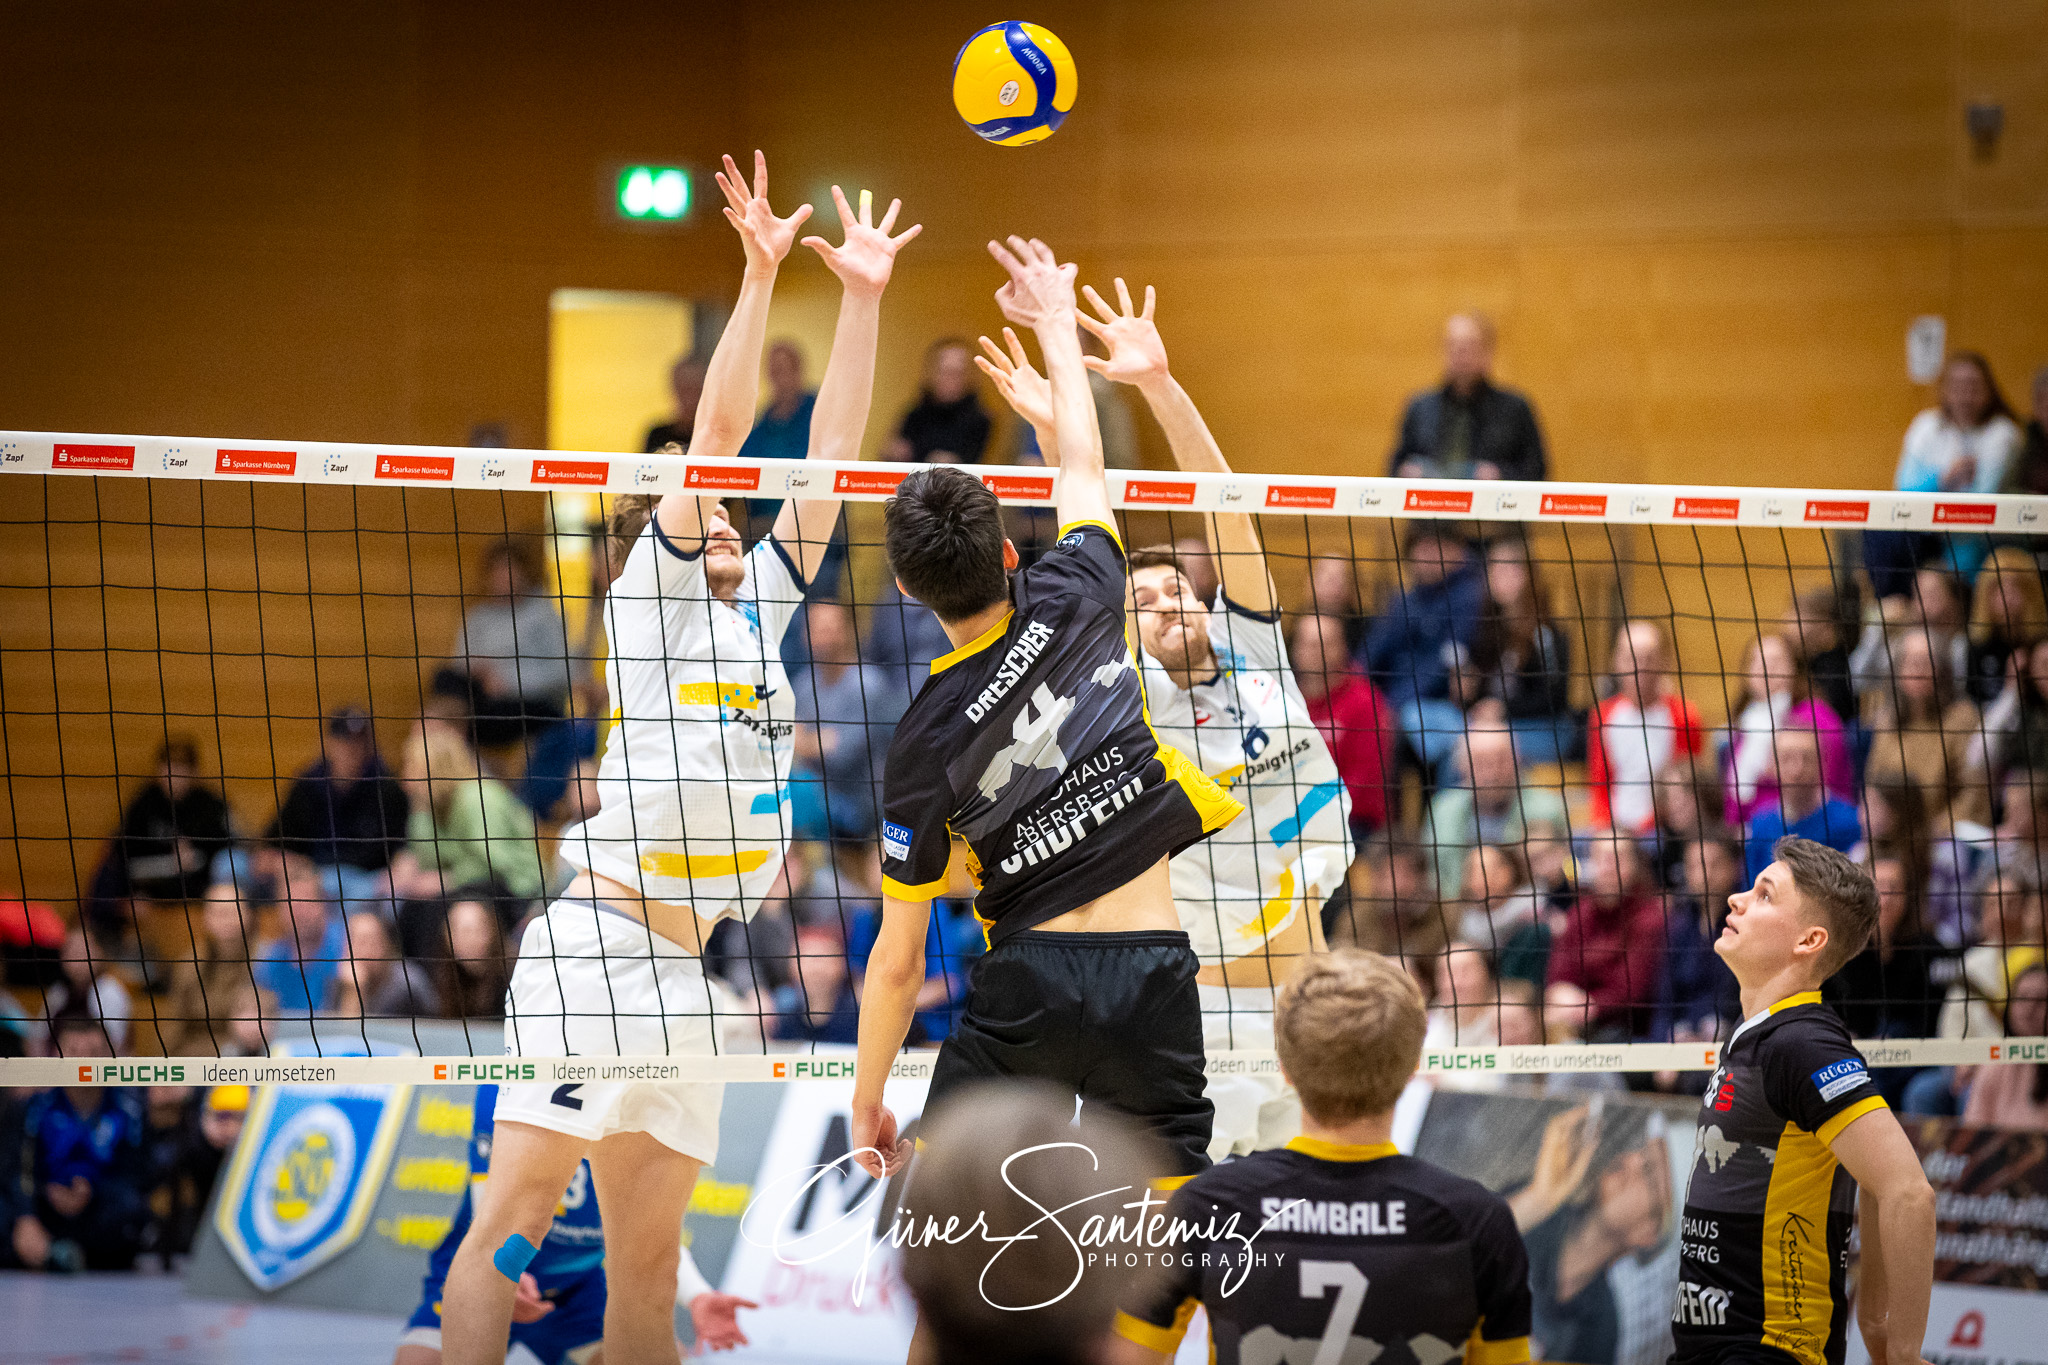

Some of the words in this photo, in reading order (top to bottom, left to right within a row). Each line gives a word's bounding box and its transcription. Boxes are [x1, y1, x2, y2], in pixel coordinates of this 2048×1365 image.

[5, 454, 24, 462] Zapf
[70, 455, 100, 463] Sparkasse
[100, 456, 128, 466] Nürnberg
[169, 459, 188, 467] Zapf
[233, 460, 262, 468] Sparkasse
[263, 461, 290, 470] Nürnberg
[330, 464, 348, 472] Zapf
[392, 466, 420, 474] Sparkasse
[422, 467, 448, 476] Nürnberg
[488, 469, 505, 477] Zapf
[576, 471, 602, 480] Nürnberg
[641, 474, 658, 482] Zapf
[701, 476, 728, 484] Sparkasse
[729, 477, 755, 486] Nürnberg
[792, 479, 809, 487] Zapf
[965, 620, 1054, 724] DRESCHER
[1016, 746, 1124, 838] AOHAUS
[1863, 1048, 1912, 1063] setzen
[2009, 1044, 2048, 1060] FUC
[1428, 1054, 1496, 1069] FUCHS
[1511, 1052, 1549, 1068] Ideen
[1554, 1051, 1622, 1068] umsetzen
[103, 1065, 185, 1082] FUCHS
[203, 1064, 248, 1082] Ideen
[255, 1065, 335, 1082] umsetzen
[457, 1064, 535, 1080] FUCHS
[553, 1063, 596, 1080] Ideen
[602, 1062, 679, 1079] umsetzen
[796, 1062, 854, 1077] FUCH
[891, 1061, 928, 1077] deen
[1261, 1197, 1407, 1236] SAMBALE
[1300, 1259, 1370, 1365] 7
